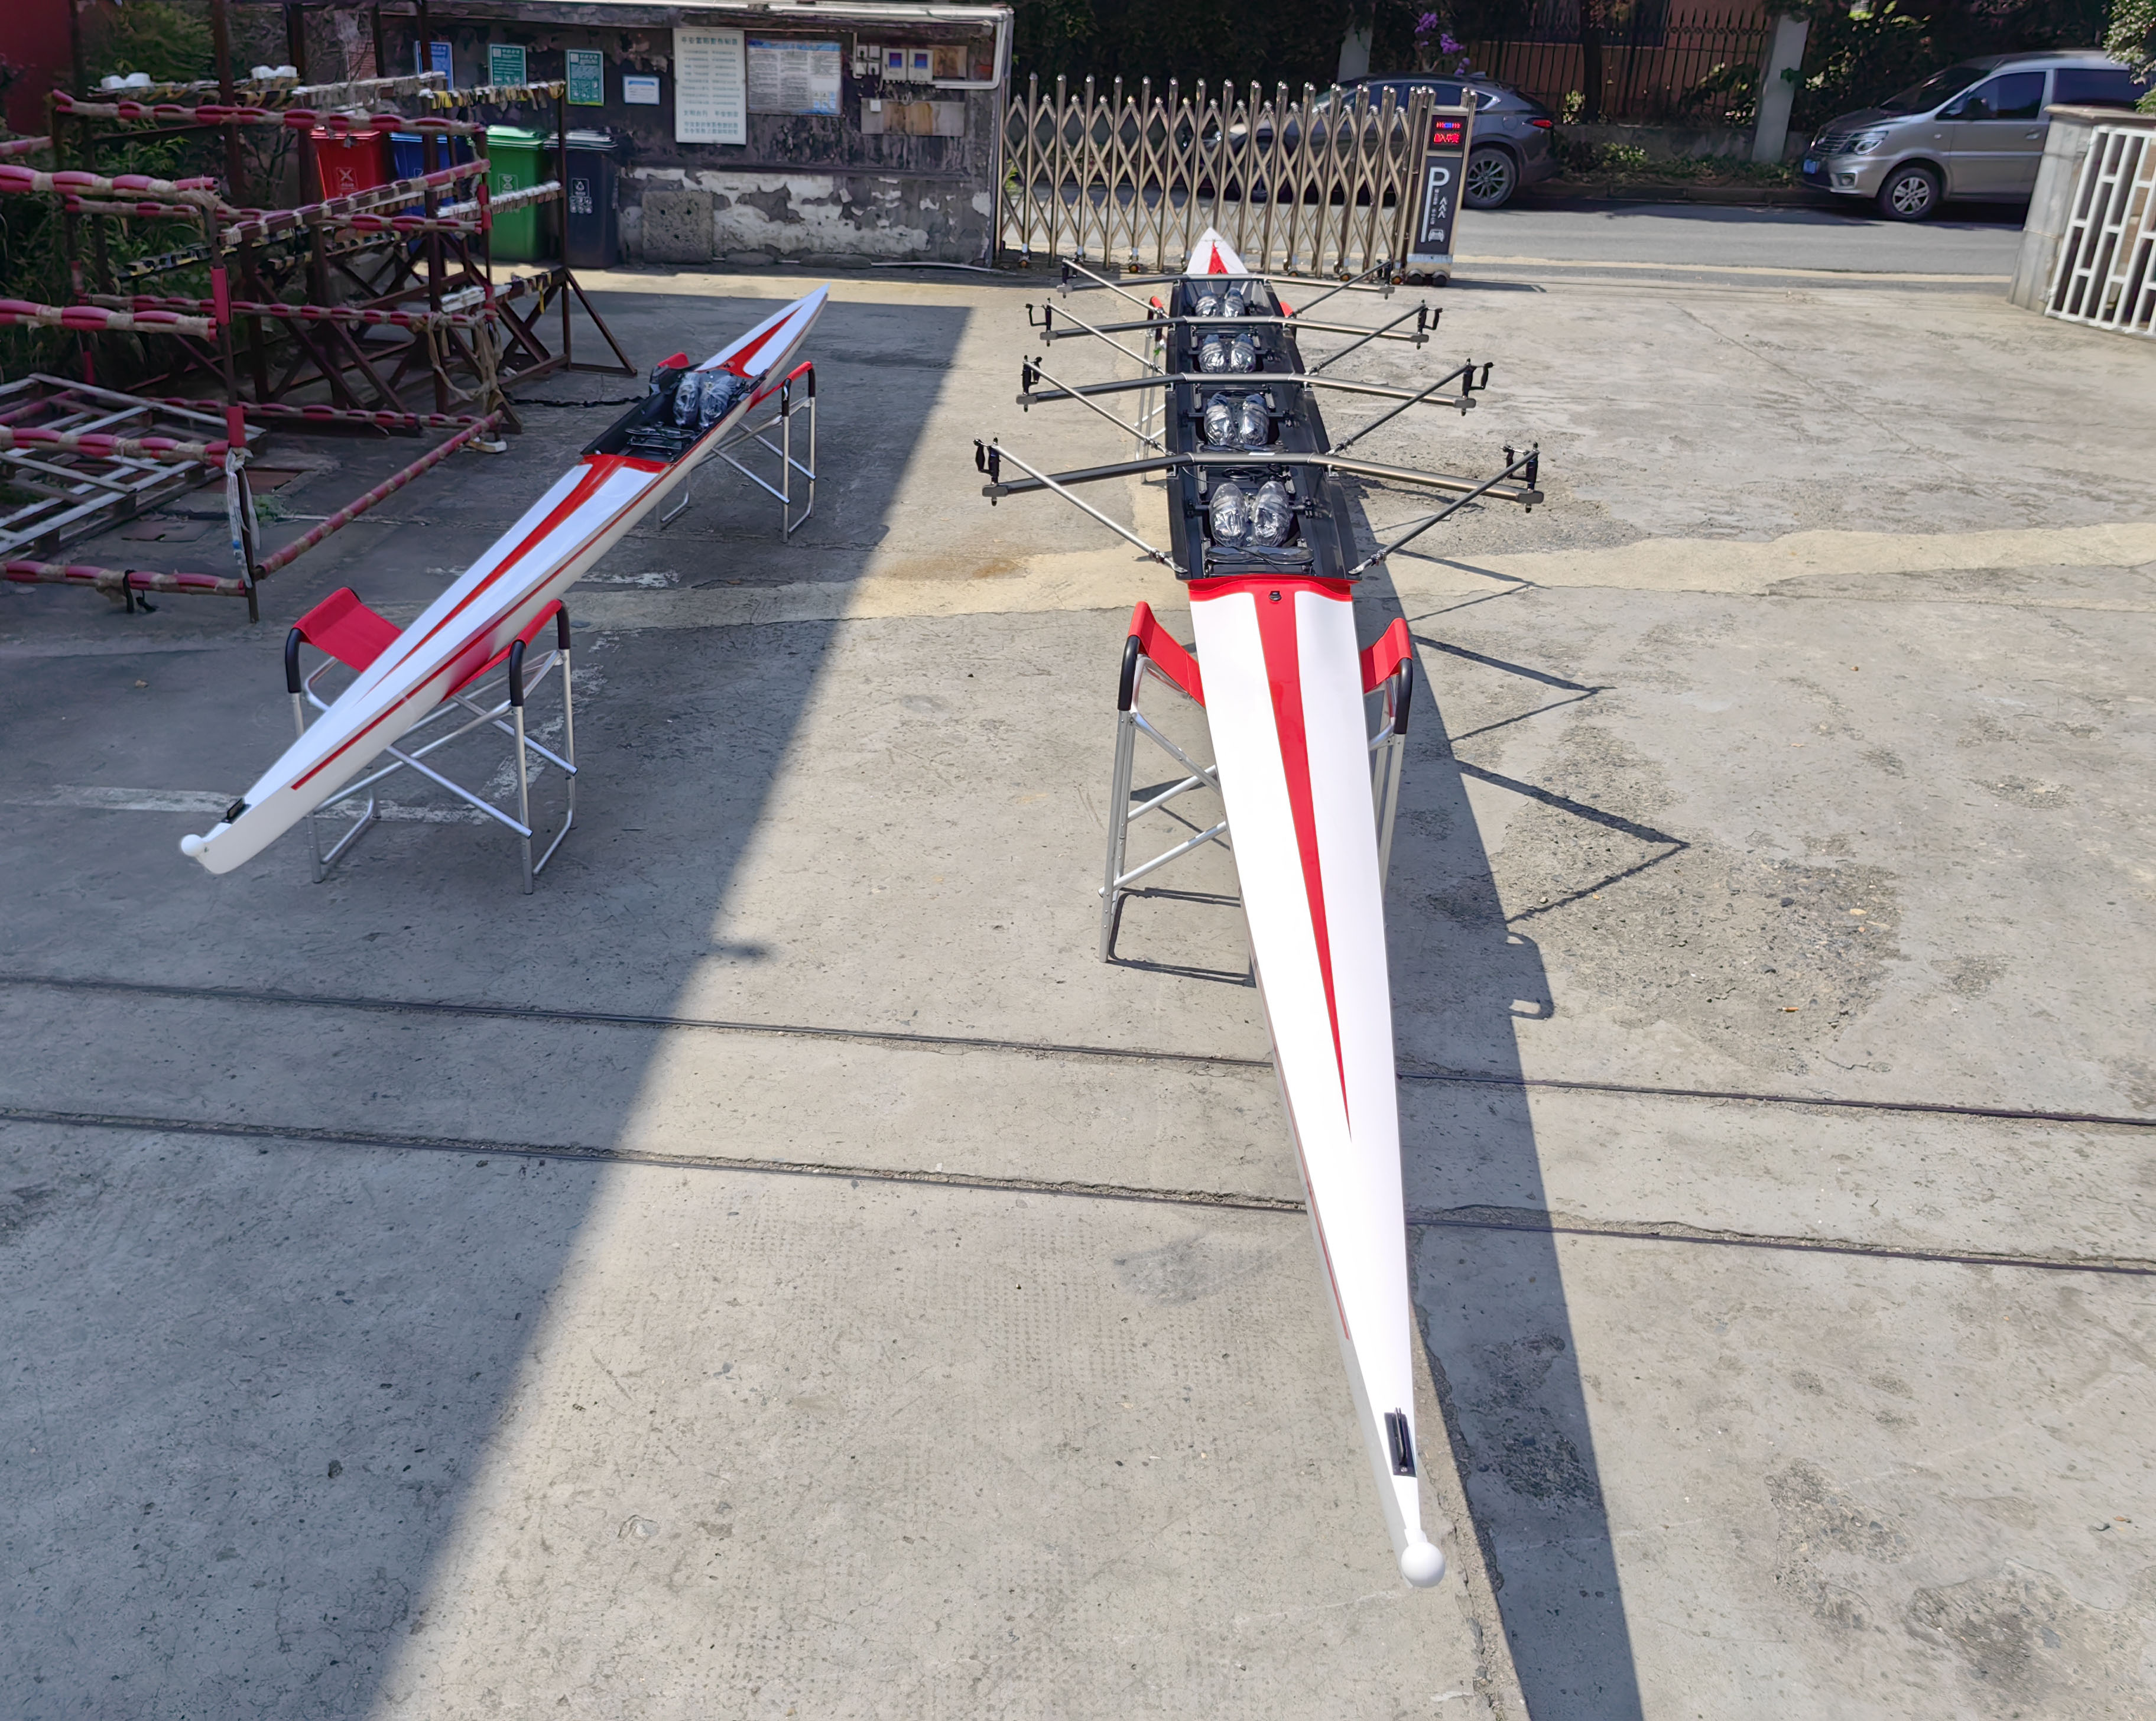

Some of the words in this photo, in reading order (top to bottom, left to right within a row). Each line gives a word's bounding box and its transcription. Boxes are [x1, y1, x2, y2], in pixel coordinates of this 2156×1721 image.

[1433, 132, 1460, 144] 出入平安
[1420, 166, 1450, 243] P
